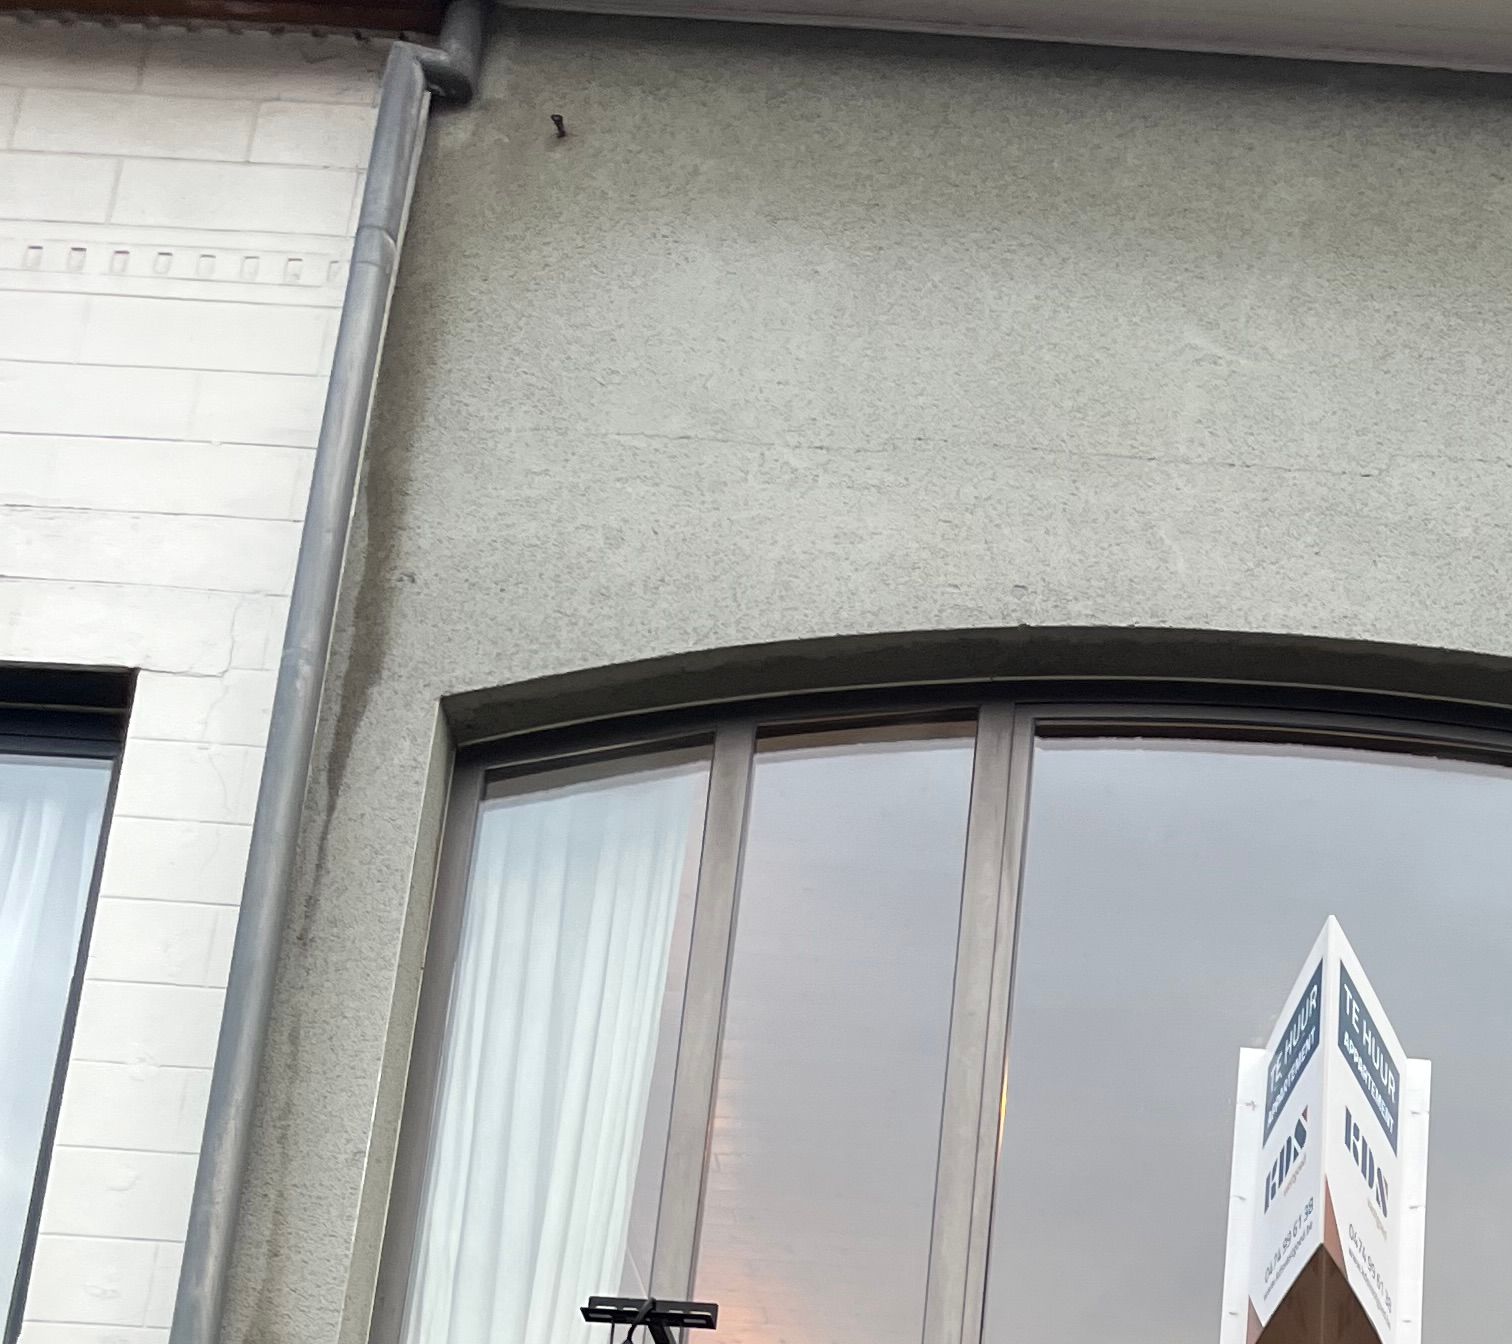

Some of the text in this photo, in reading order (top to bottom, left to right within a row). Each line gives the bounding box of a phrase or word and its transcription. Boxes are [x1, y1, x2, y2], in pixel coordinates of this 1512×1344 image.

[1266, 1025, 1316, 1128] APPARTEMENT
[1270, 984, 1318, 1092] TE HUUR
[1343, 983, 1396, 1104] TE HUUR
[1343, 1030, 1394, 1134] APPARTEMENT
